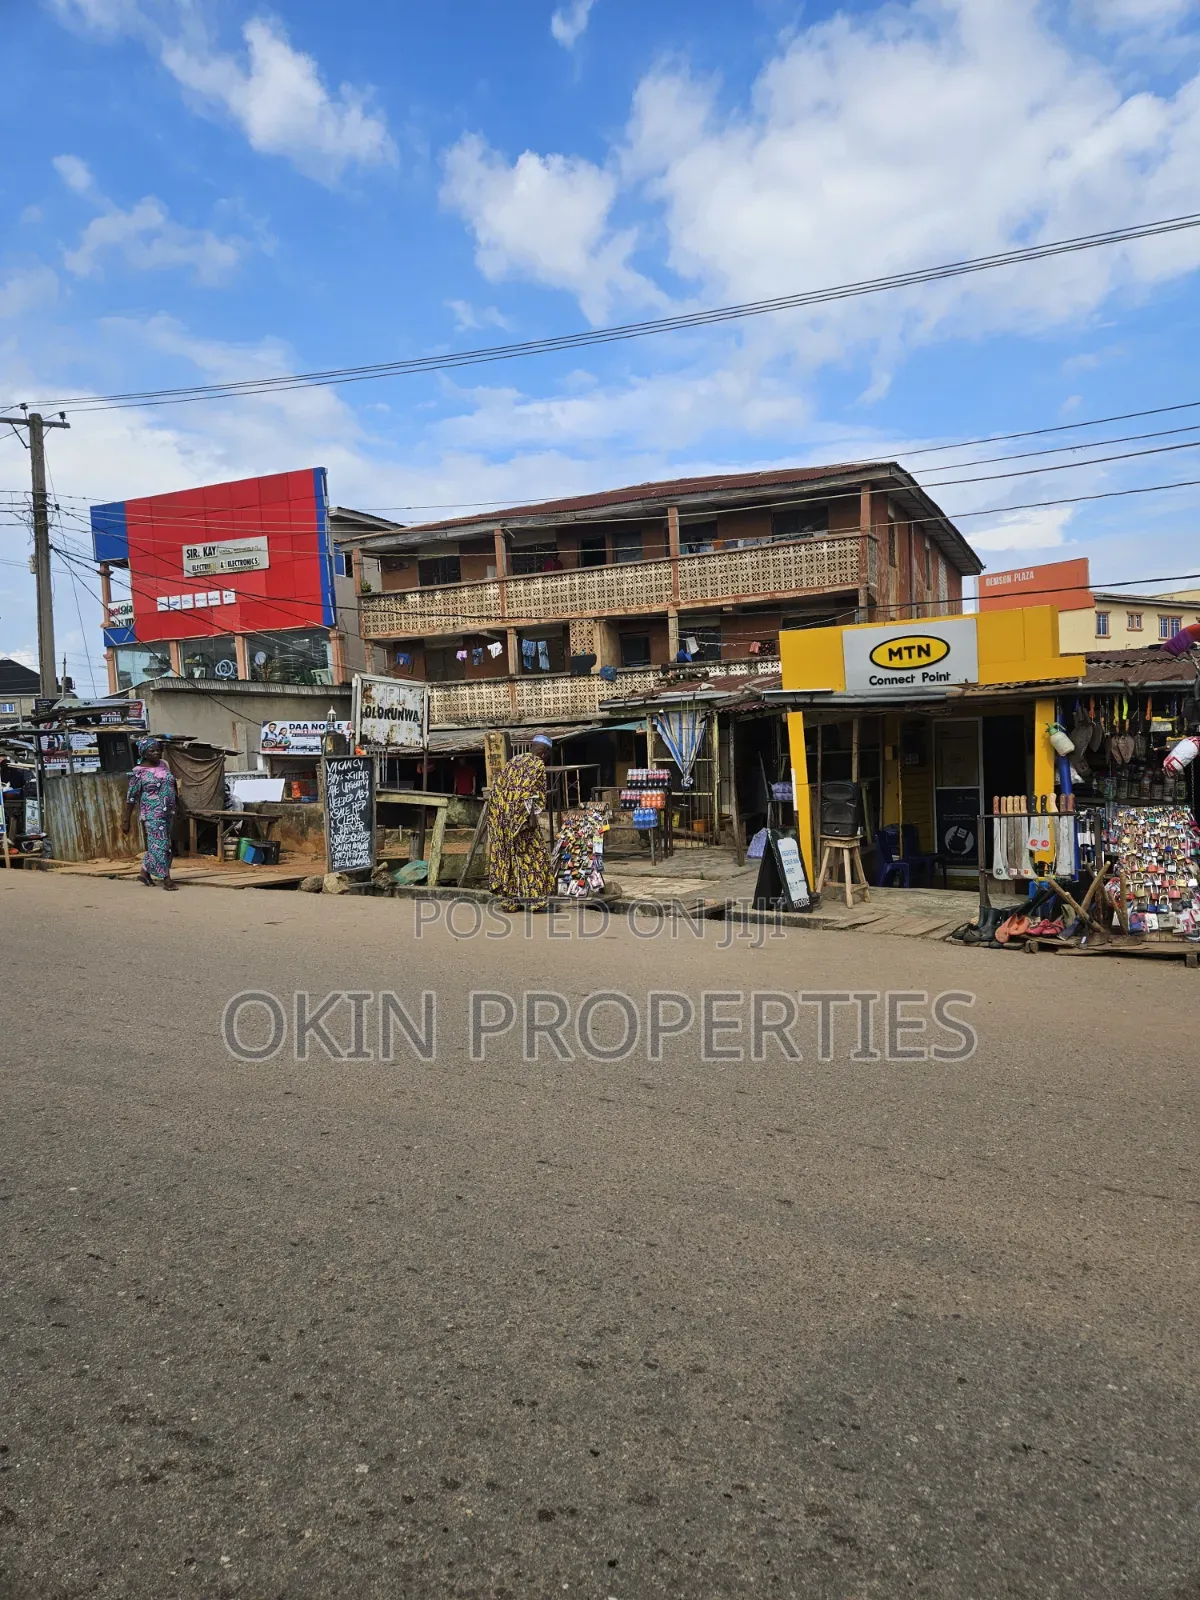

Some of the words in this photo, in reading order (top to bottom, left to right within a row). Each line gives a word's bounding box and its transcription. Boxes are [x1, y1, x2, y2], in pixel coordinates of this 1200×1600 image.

[203, 546, 216, 557] KAY
[228, 558, 258, 568] ELECTRONICS
[1014, 571, 1034, 582] PLAZA
[888, 643, 931, 661] MTN
[869, 674, 915, 686] Connect
[922, 672, 951, 683] Point
[365, 704, 420, 722] OLORUNWA
[326, 759, 363, 774] VACANCY
